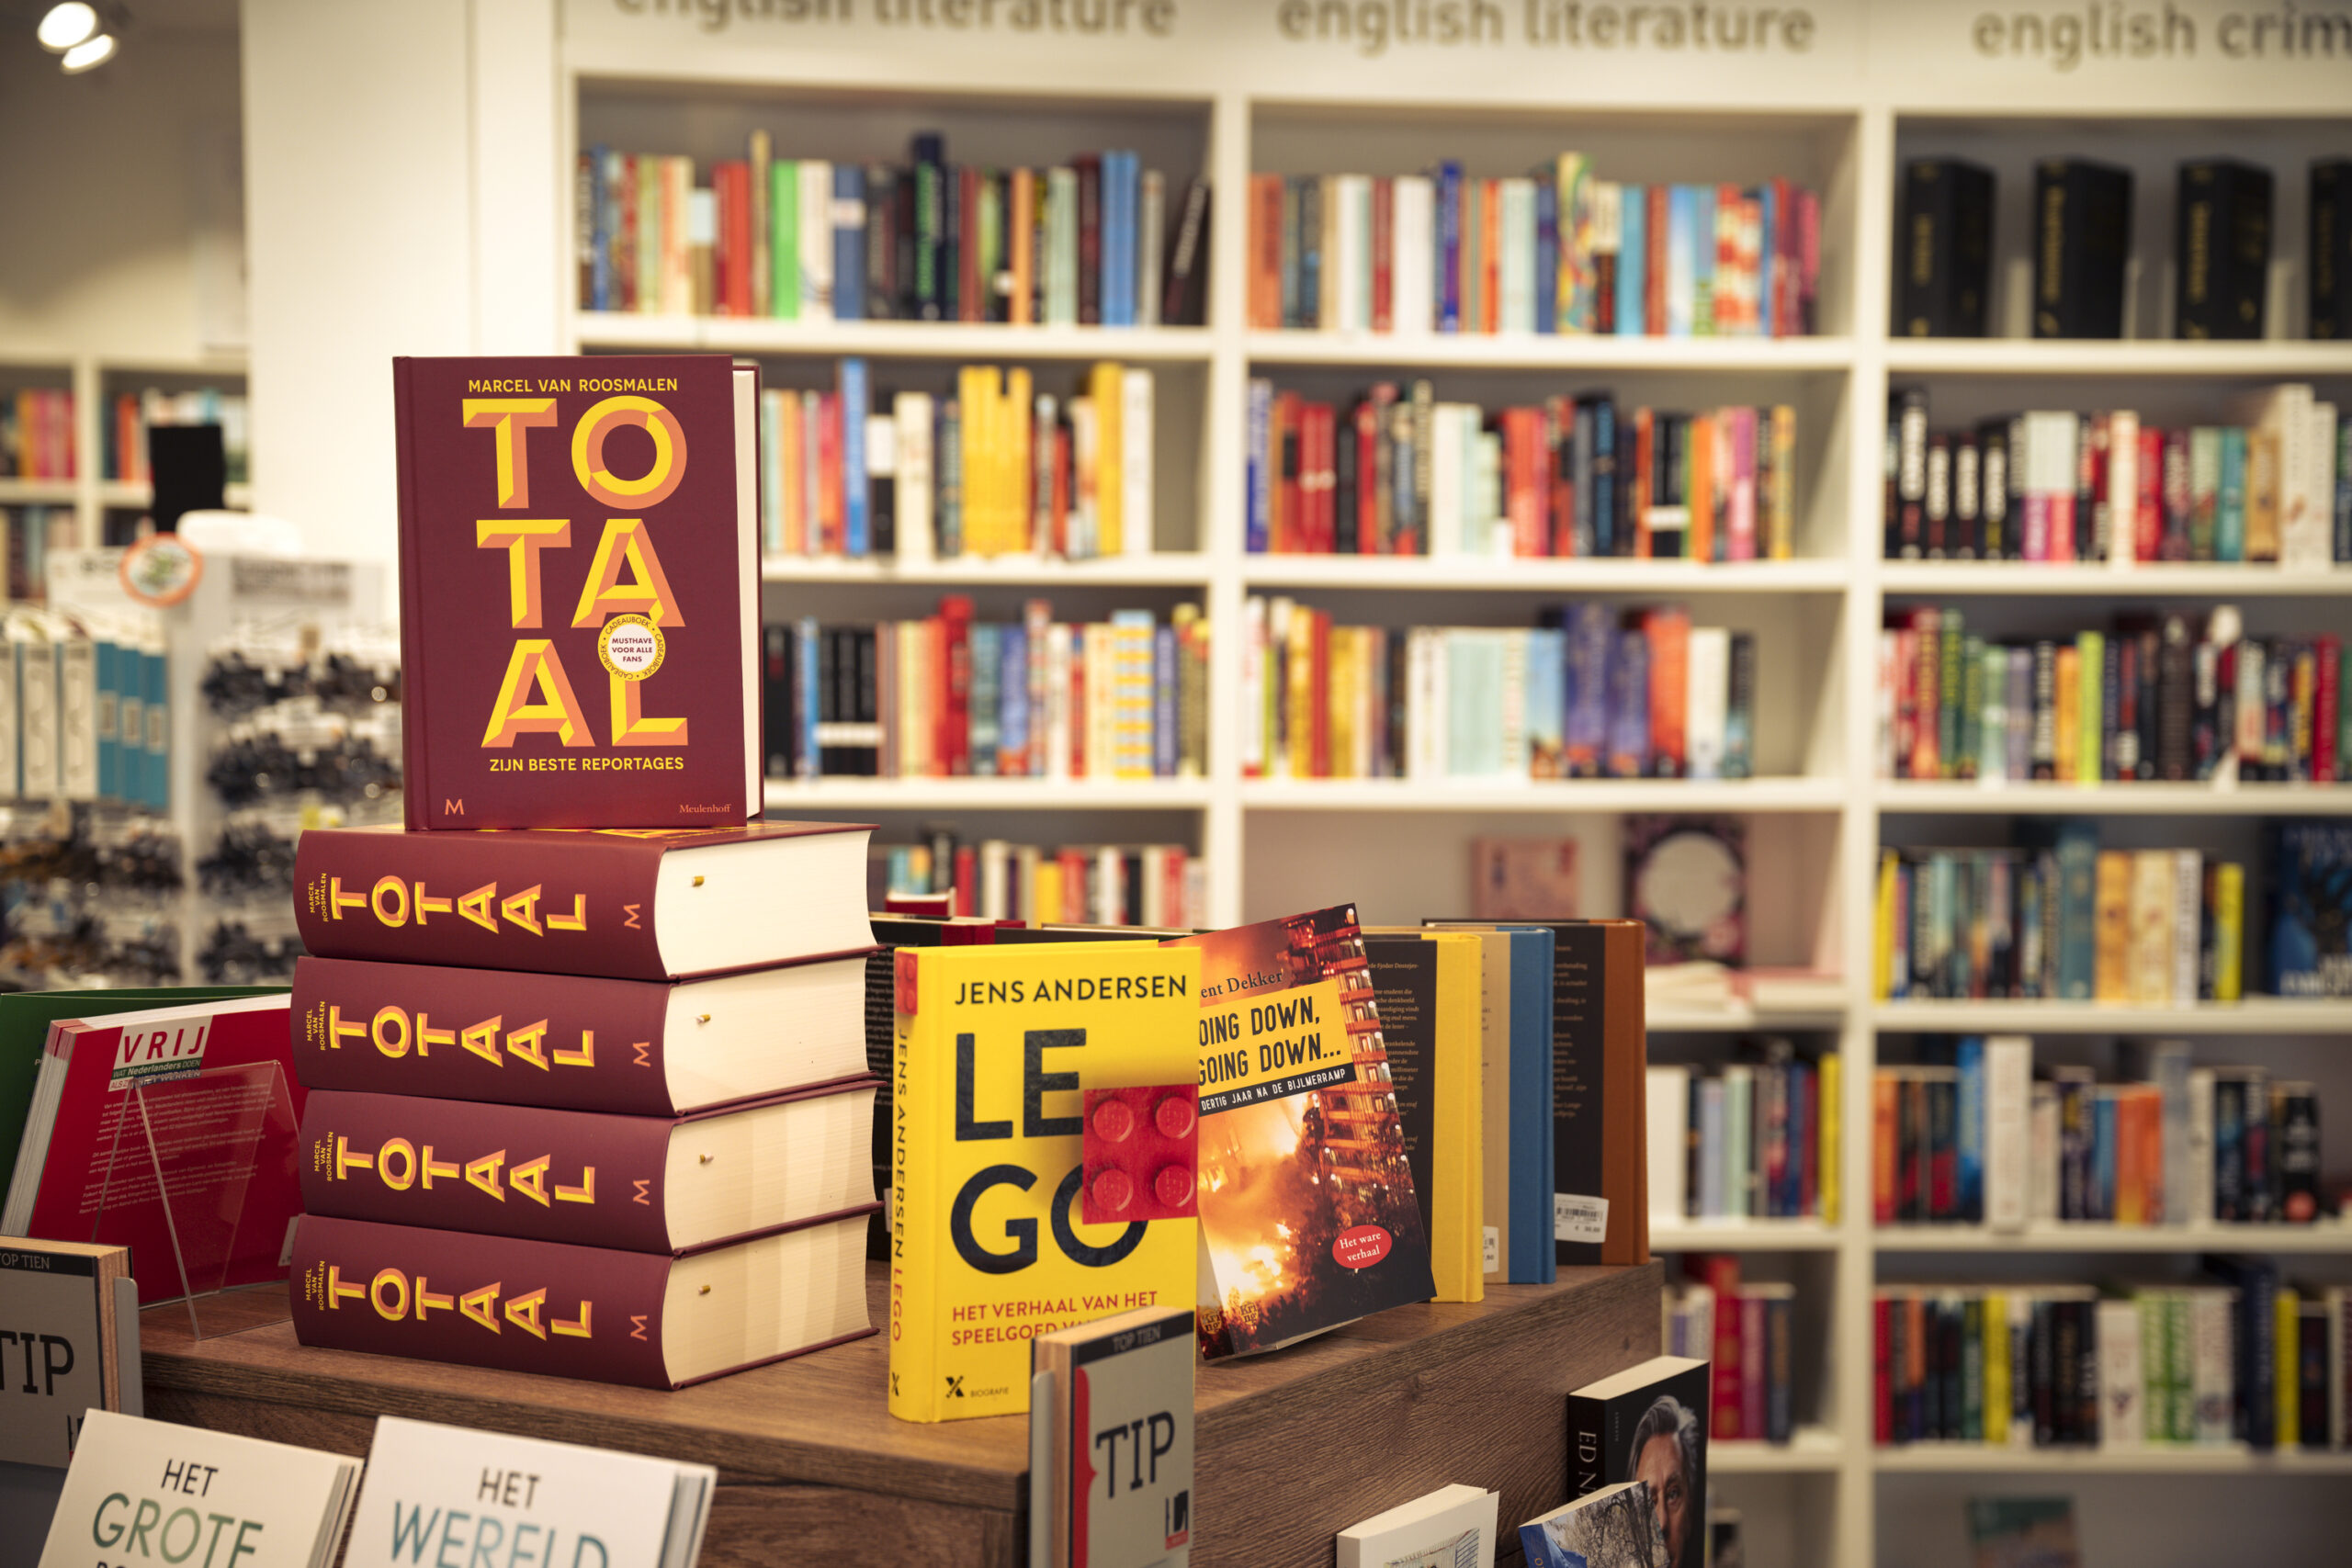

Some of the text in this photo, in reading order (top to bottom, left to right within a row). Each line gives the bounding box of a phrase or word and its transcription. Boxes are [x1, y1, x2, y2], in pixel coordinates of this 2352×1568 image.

[1277, 0, 1816, 56] english literature
[1972, 2, 2352, 73] english crim
[469, 378, 678, 393] MARCEL VAN ROOSMALEN
[462, 395, 687, 510] TO
[476, 518, 686, 628] TA
[605, 616, 651, 635] CADEAUBOEK
[600, 644, 634, 680] CADEAUBOEK
[642, 633, 664, 677] CADEAUBOEK
[481, 638, 688, 748] AL
[489, 757, 684, 773] ZIJN BESTE REPORTAGES
[445, 798, 465, 816] M
[679, 802, 731, 814] Meulenhoff
[321, 873, 329, 922] ROOSMALEN
[330, 874, 587, 937] TOTAAL
[955, 975, 1187, 1006] JENS ANDERSEN
[1200, 971, 1283, 998] ent Dekker
[329, 1005, 594, 1072] TOTAAL
[1199, 996, 1320, 1047] OING DOWN,
[124, 1026, 205, 1064] VRIJ
[1259, 1032, 1341, 1073] DOWN...
[128, 1062, 182, 1076] Nederlanders
[182, 1060, 201, 1068] DOEN
[955, 1028, 1087, 1141] LE
[1201, 1068, 1346, 1111] DERTIG JAAR NA DE BIJLMERRAMP
[336, 1135, 595, 1207] TOTAAL
[891, 1029, 909, 1342] JENS ANDERSEN LEGO
[950, 1161, 1149, 1275] GO
[0, 1252, 51, 1270] OP TIEN
[1339, 1233, 1381, 1249] Het ware
[1347, 1244, 1380, 1262] verhaal
[327, 1265, 593, 1341] TOTAAL
[952, 1291, 1158, 1322] HET VERHAAL VAN HET
[952, 1322, 1057, 1346] SPEELGOED
[1112, 1324, 1162, 1353] TOP TIEN
[970, 1387, 1010, 1398] BIOGRAFIE
[1095, 1411, 1176, 1499] TIP
[1578, 1431, 1597, 1497] ED N
[161, 1459, 219, 1497] HET
[477, 1466, 541, 1509] HET
[92, 1492, 265, 1568] GROTE
[391, 1500, 609, 1568] WERELD
